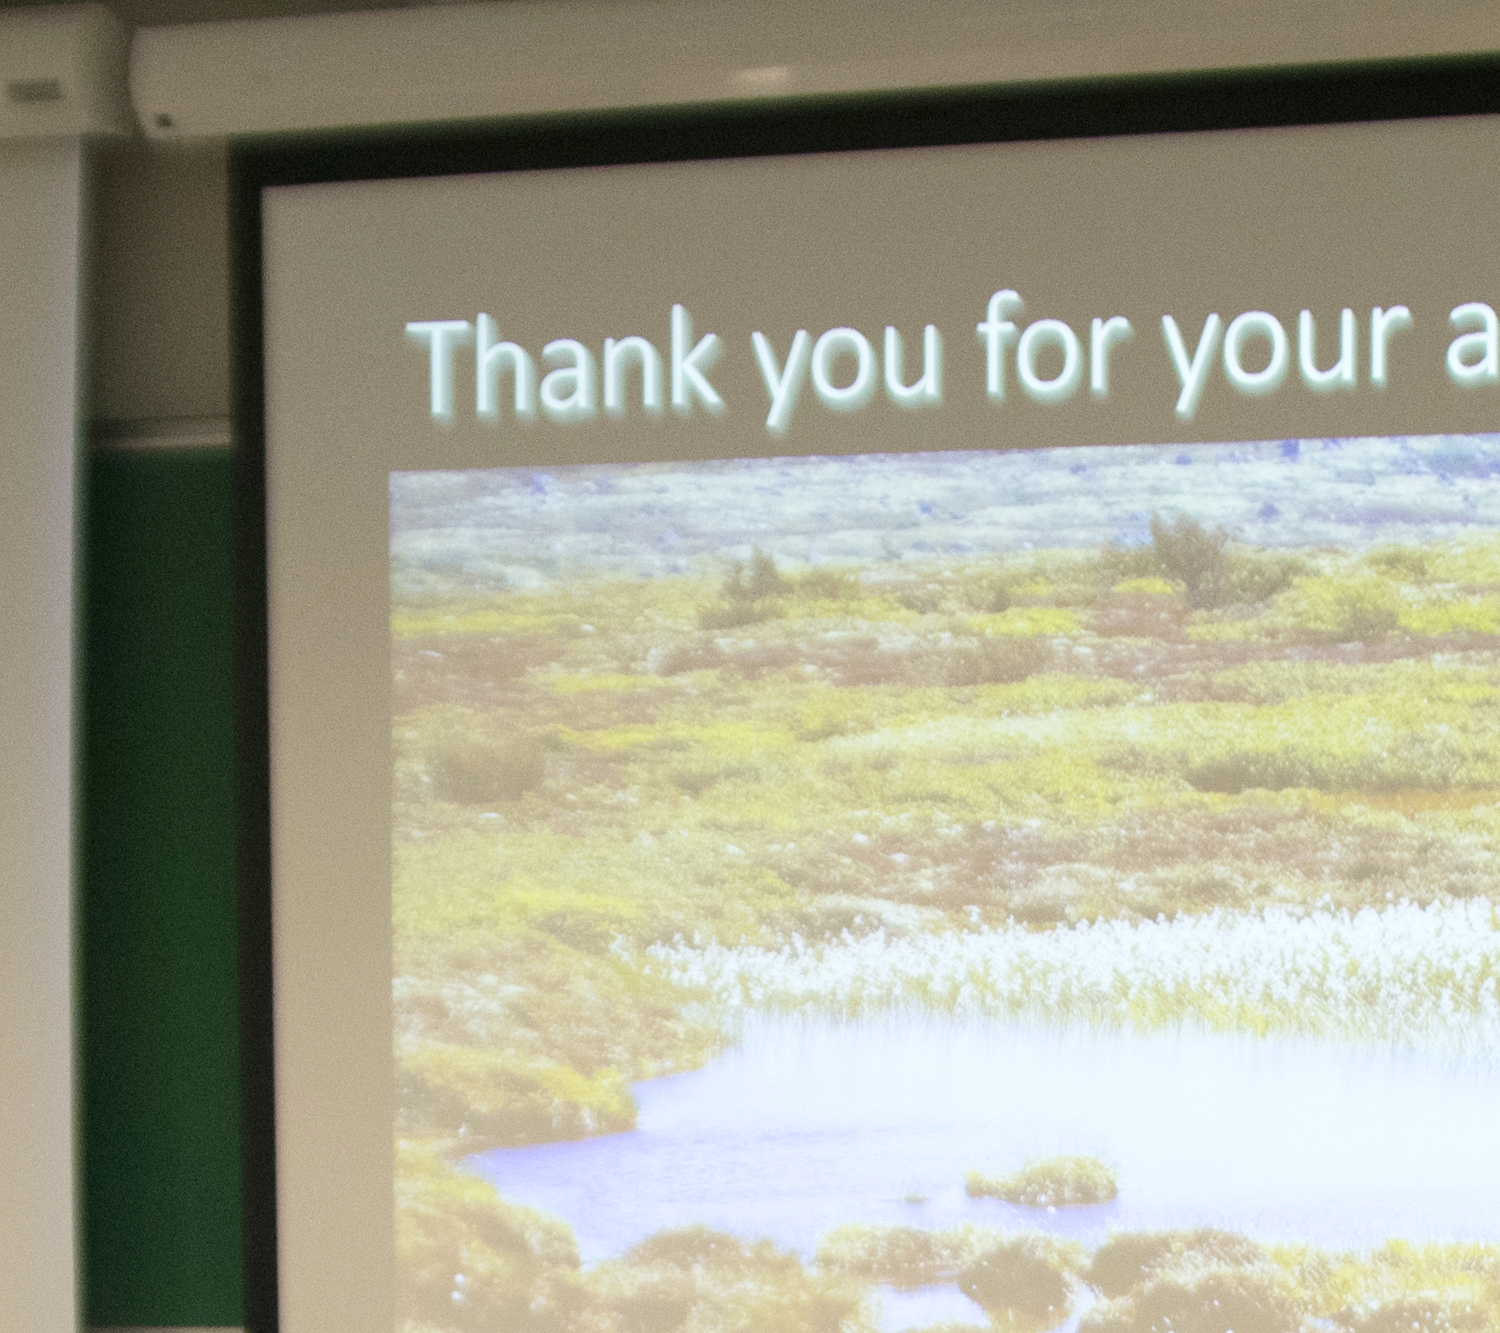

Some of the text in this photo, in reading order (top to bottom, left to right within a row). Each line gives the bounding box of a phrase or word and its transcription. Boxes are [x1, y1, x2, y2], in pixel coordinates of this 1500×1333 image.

[404, 303, 724, 419] Thank
[750, 324, 946, 434] you
[977, 288, 1132, 401] for
[1160, 298, 1414, 415] your
